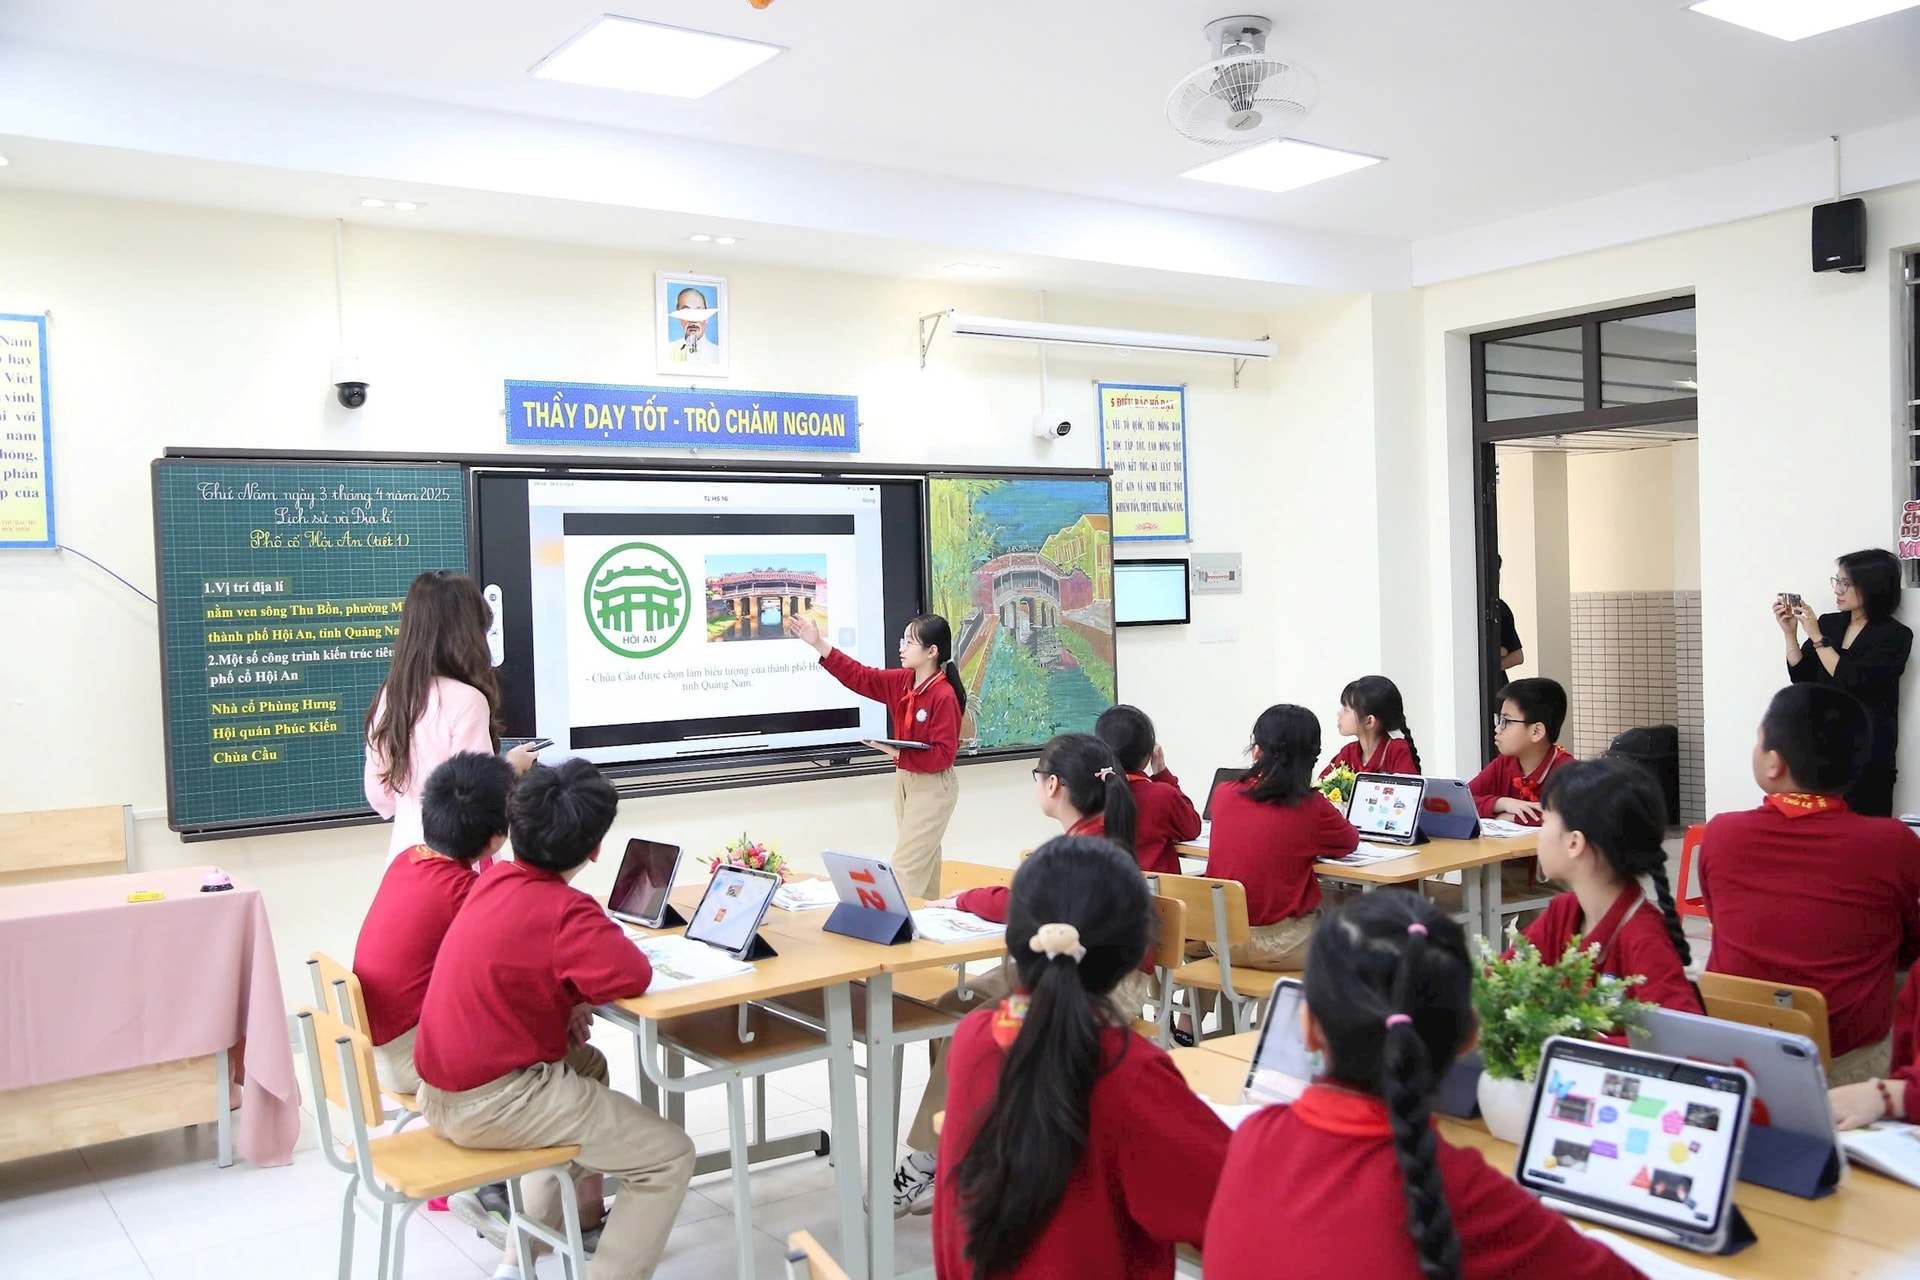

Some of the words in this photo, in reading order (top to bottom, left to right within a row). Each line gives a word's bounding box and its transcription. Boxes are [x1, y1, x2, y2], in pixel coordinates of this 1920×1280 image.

[522, 391, 578, 429] THẦY
[584, 403, 626, 438] DẠY
[631, 394, 669, 431] TỐT
[684, 401, 721, 433] TRÒ
[725, 403, 778, 435] CHĂM
[783, 411, 845, 437] NGOAN
[197, 482, 234, 501] Thứ
[238, 482, 278, 501] Năm
[283, 488, 316, 510] ngày
[319, 487, 328, 501] 3
[332, 484, 373, 510] tháng
[376, 487, 383, 501] 4
[386, 490, 419, 501] năm
[420, 487, 450, 501] 2025
[275, 507, 309, 526] Lịch
[312, 510, 329, 524] sử
[333, 511, 349, 524] và
[351, 506, 378, 525] Địa
[380, 507, 394, 524] lí
[250, 529, 283, 549] Phố
[287, 534, 300, 548] cổ
[304, 530, 333, 550] Hội
[337, 530, 363, 548] An
[367, 532, 393, 548] (tiết
[396, 533, 410, 547] 1)
[204, 581, 230, 596] 1.Vị
[234, 581, 250, 593] trí
[253, 581, 272, 595] địa
[275, 580, 284, 592] lí
[206, 604, 234, 618] nằm
[237, 608, 257, 617] ven
[261, 605, 288, 619] sông
[289, 604, 313, 616] Thu
[317, 601, 343, 616] Bồn,
[346, 602, 388, 617] phường
[391, 601, 404, 613] M
[208, 630, 243, 643] thành
[246, 626, 269, 645] phố
[272, 629, 293, 642] Hội
[296, 629, 316, 641] An,
[319, 627, 342, 639] tỉnh
[345, 626, 382, 639] Quảng
[384, 625, 400, 636] Na
[643, 634, 657, 644] AN
[207, 652, 244, 668] 2.Một
[246, 649, 259, 664] số
[262, 651, 289, 665] công
[292, 650, 320, 662] trình
[323, 646, 347, 660] kiến
[350, 647, 373, 659] trúc
[808, 662, 823, 672] Hộ
[210, 670, 234, 687] phố
[238, 669, 252, 683] cổ
[255, 671, 278, 684] Hội
[281, 670, 298, 681] An
[211, 702, 238, 715] Nhà
[241, 699, 256, 713] cổ
[259, 700, 299, 713] Phùng
[302, 699, 337, 711] Hưng
[213, 727, 236, 741] Hội
[239, 725, 271, 739] quán
[275, 723, 306, 735] Phúc
[309, 719, 337, 733] Kiến
[213, 751, 248, 764] Chùa
[252, 747, 277, 761] Cầu
[849, 868, 887, 912] 12
